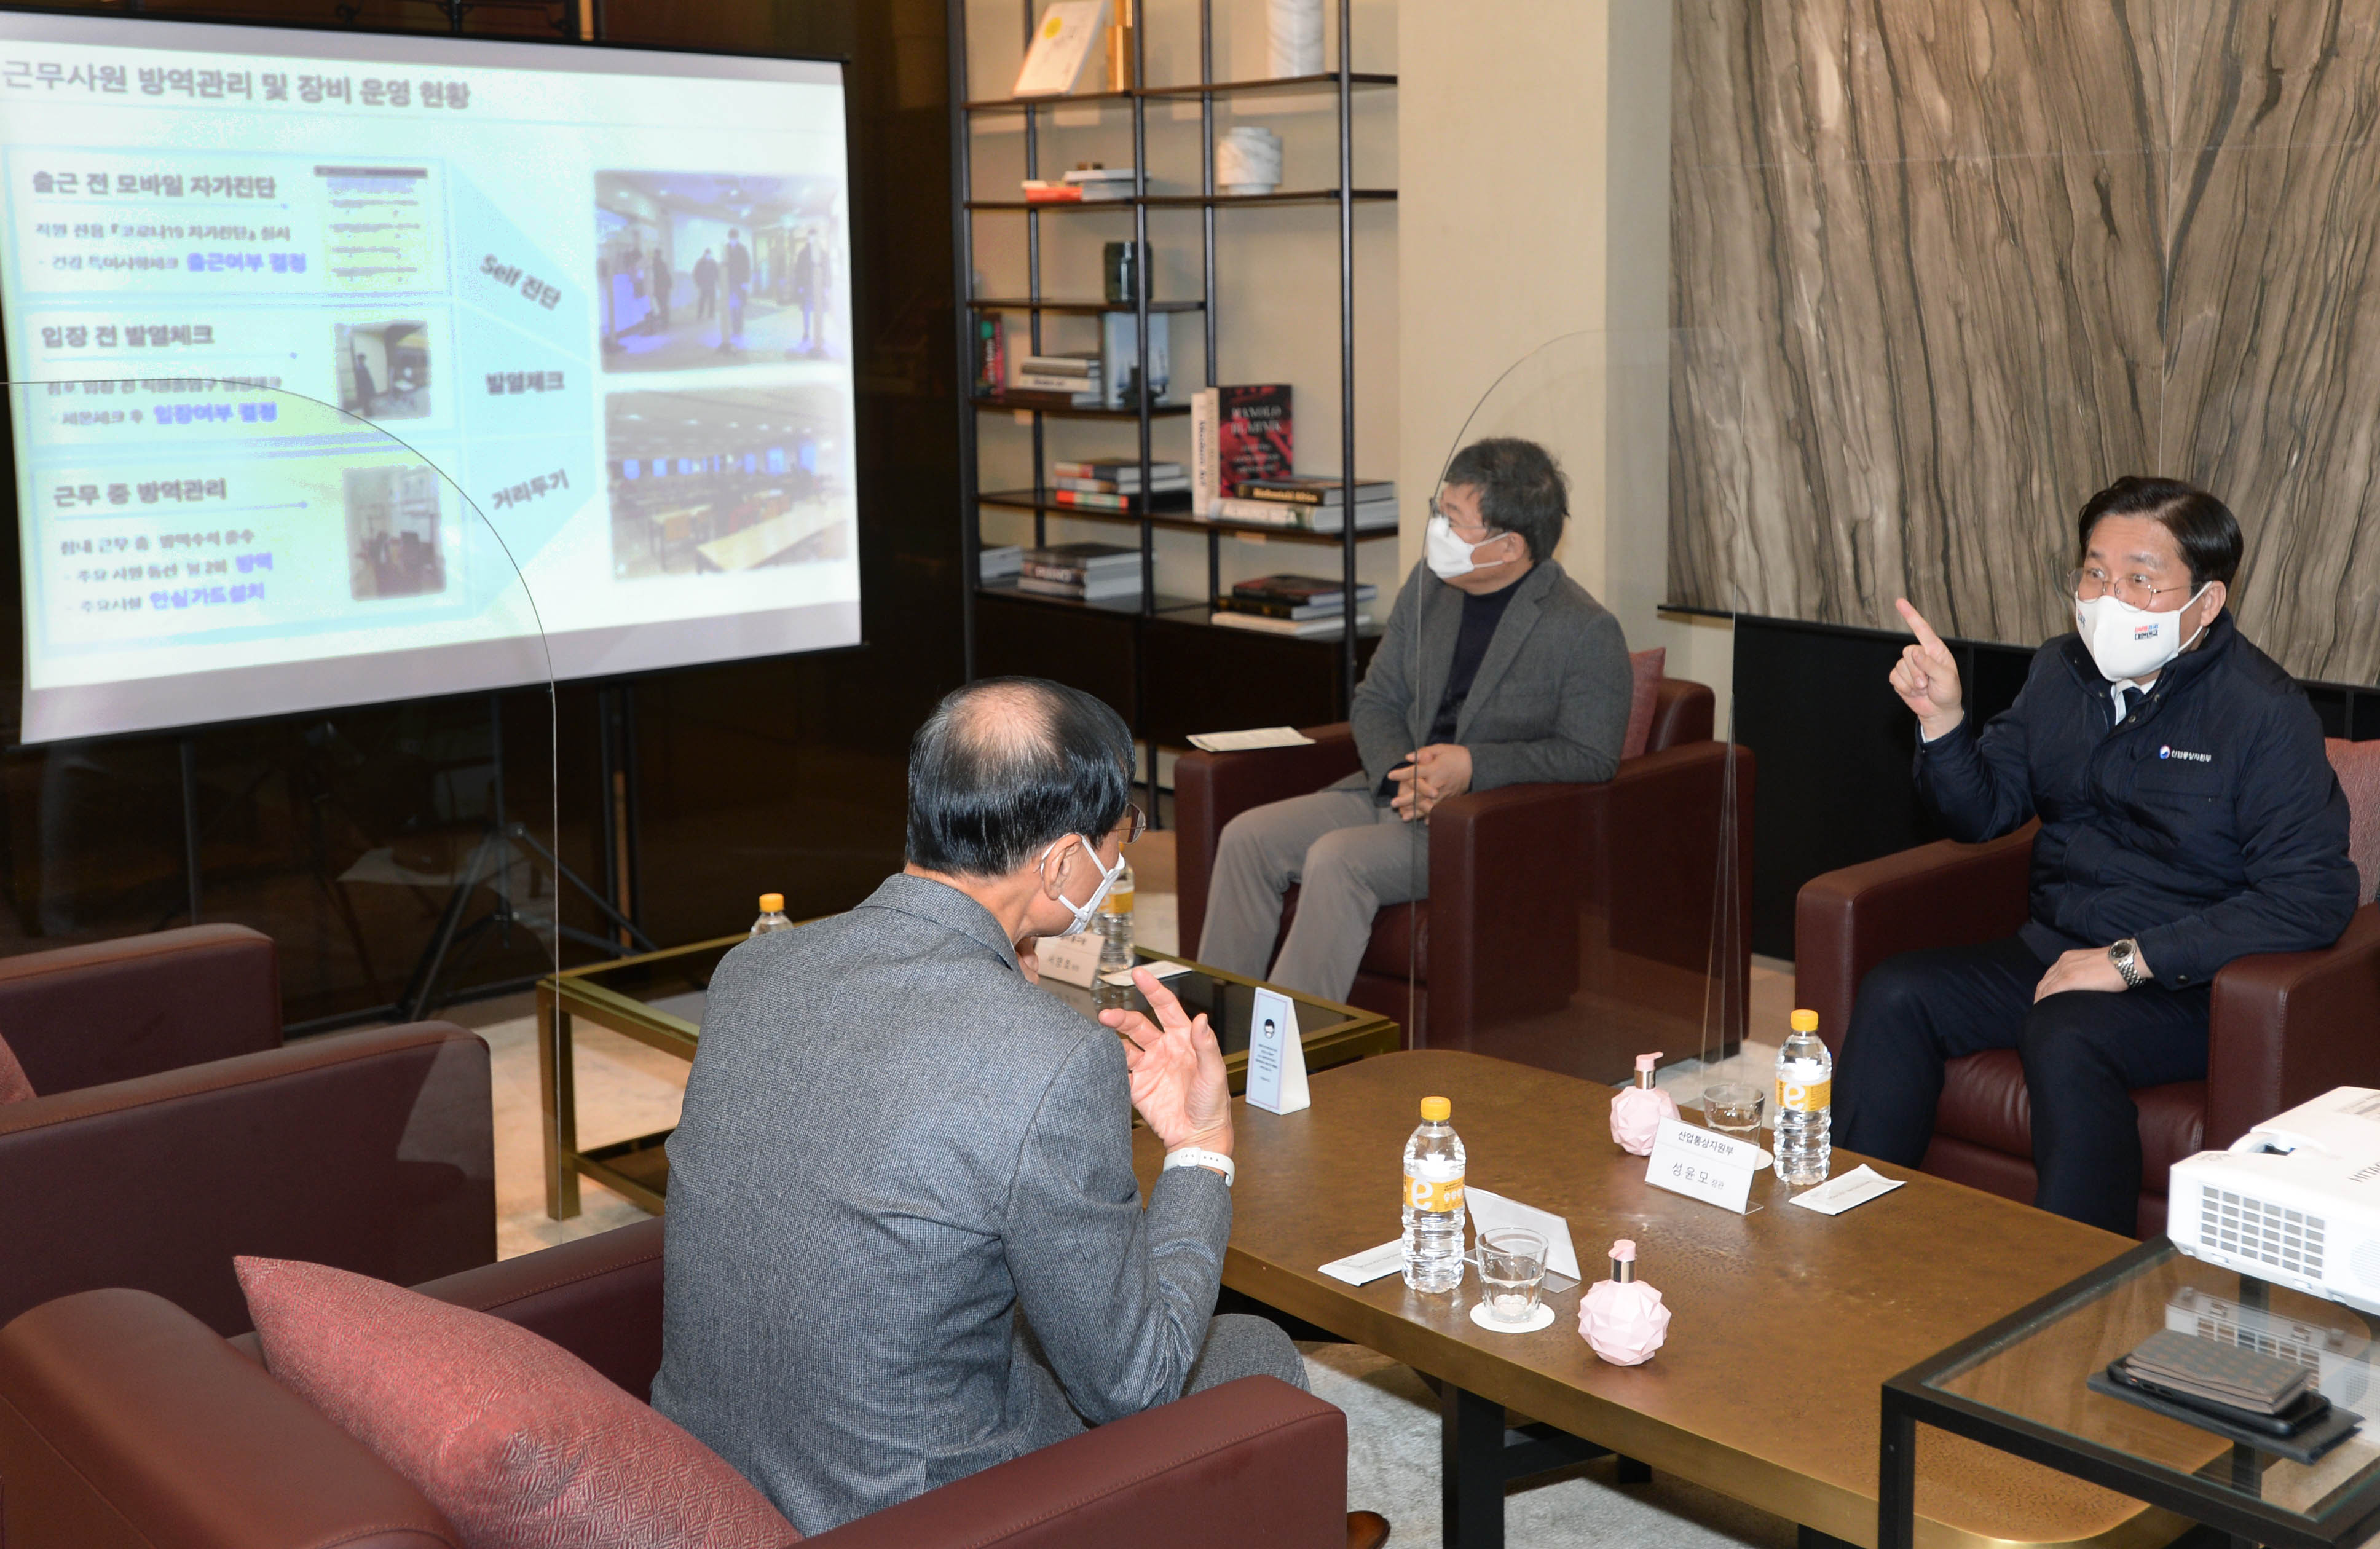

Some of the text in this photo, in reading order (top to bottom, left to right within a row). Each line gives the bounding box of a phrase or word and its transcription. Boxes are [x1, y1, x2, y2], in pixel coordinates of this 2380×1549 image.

[2, 60, 471, 110] 근무사원 방역관리 및 장비 운영 현황
[33, 171, 277, 199] 출근 전 모바일 자가진단
[187, 252, 264, 272] 출근여부
[479, 254, 562, 311] Self 진단
[42, 324, 215, 348] 입장 전 발열체크
[486, 371, 565, 396] 발열체크
[154, 403, 233, 425] 입장여부
[54, 478, 227, 508] 근무 중 방역관리
[491, 468, 570, 511] 거리두기
[2171, 749, 2212, 763] 산업통상자원부
[1677, 1130, 1734, 1156] 산업통상자원부
